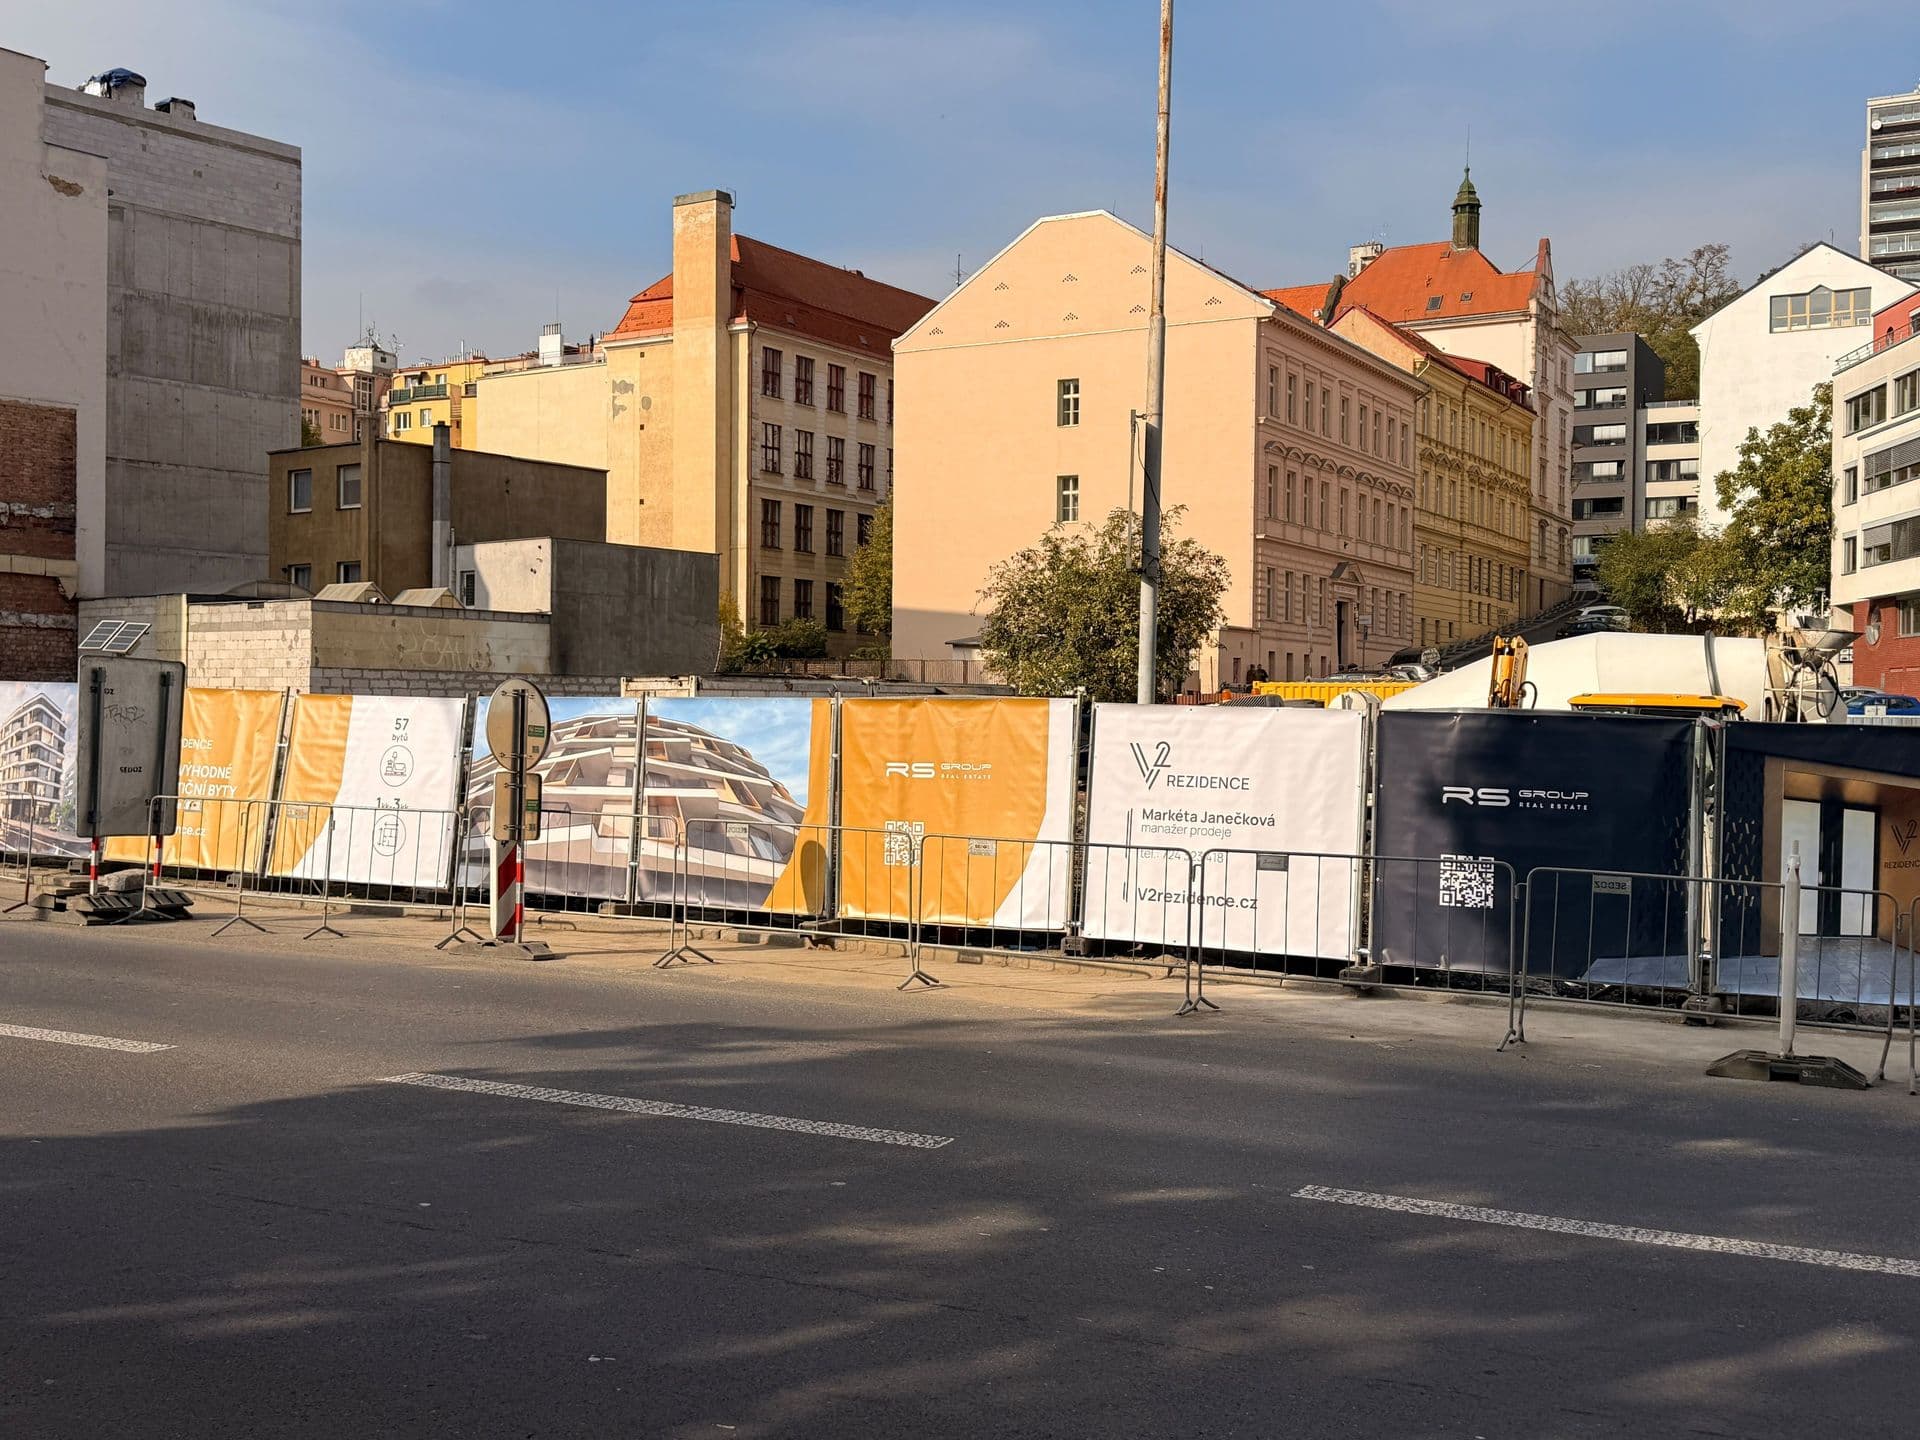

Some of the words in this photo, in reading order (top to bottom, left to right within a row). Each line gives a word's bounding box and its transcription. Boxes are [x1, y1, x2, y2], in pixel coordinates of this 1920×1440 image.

[395, 717, 409, 730] 57
[183, 738, 213, 750] DENCE
[391, 732, 408, 743] bytů
[886, 762, 935, 778] RS
[941, 763, 992, 771] GROUP
[1167, 775, 1250, 790] REZIDENCE
[207, 784, 238, 798] BYTY
[1442, 786, 1510, 806] RS
[1519, 790, 1589, 799] GROUP
[1550, 803, 1588, 811] ESTATE
[1142, 808, 1198, 823] Markéta
[1201, 811, 1276, 827] Janečková
[1141, 824, 1188, 835] manažer
[1189, 827, 1232, 840] prodeje
[1138, 888, 1258, 909] V2rezidence.cz
